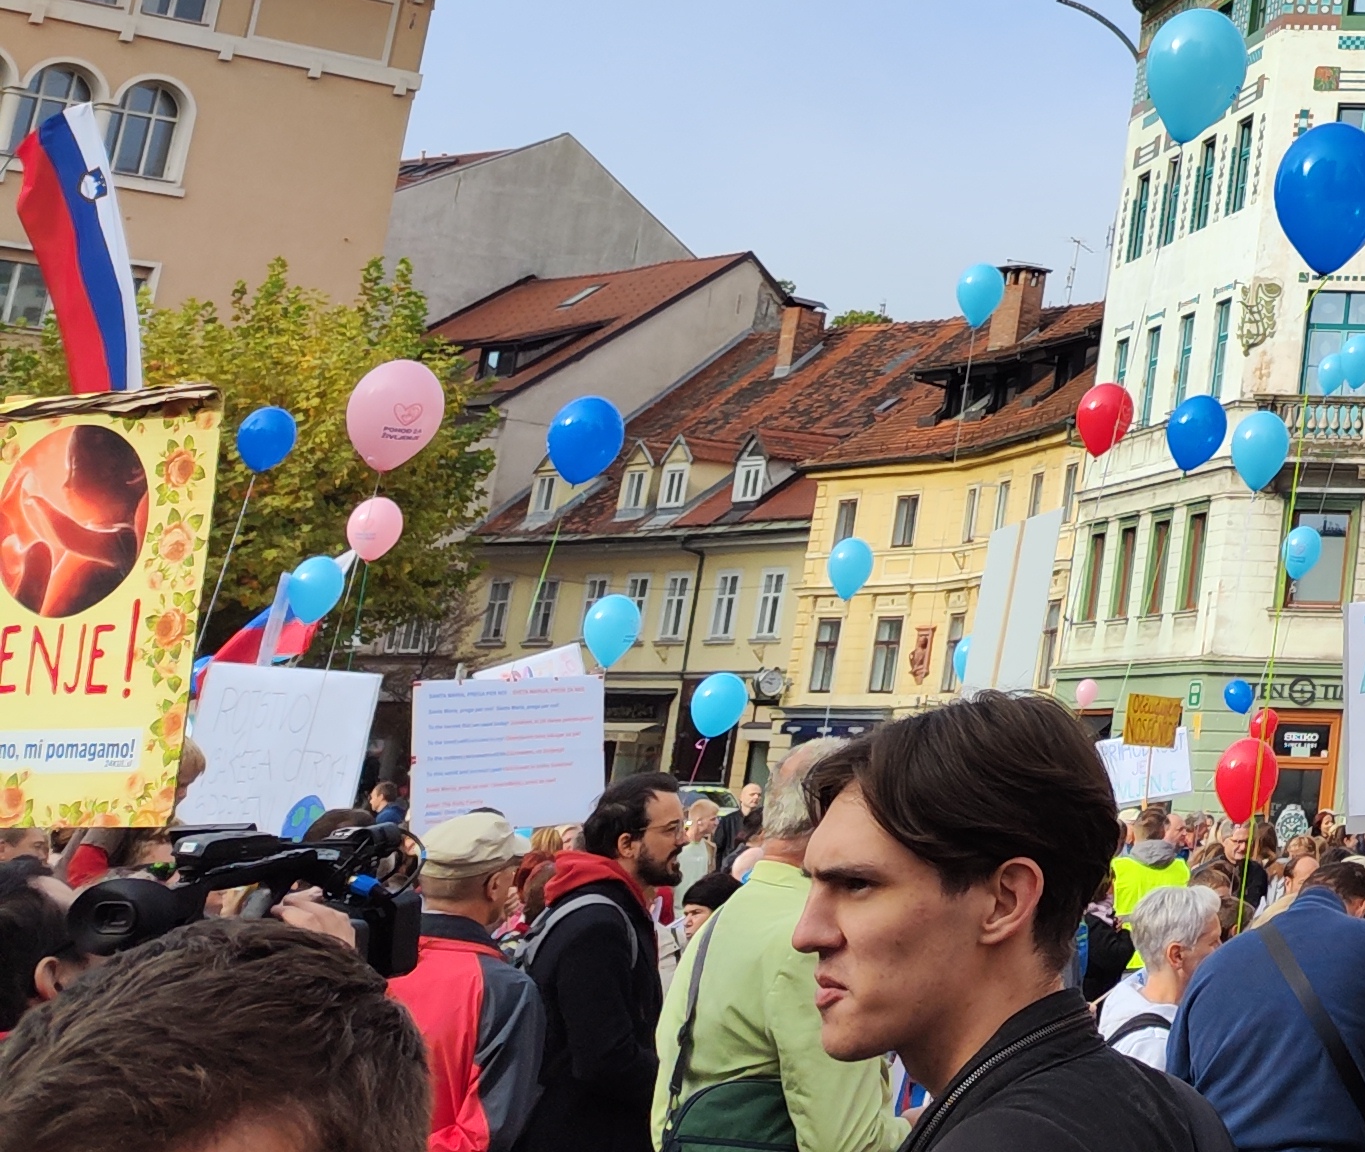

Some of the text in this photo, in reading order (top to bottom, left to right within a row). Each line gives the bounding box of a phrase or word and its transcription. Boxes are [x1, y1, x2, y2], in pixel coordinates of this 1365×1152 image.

[1284, 731, 1319, 742] SEIKO
[23, 739, 43, 759] mi
[45, 739, 136, 762] pomagamo!
